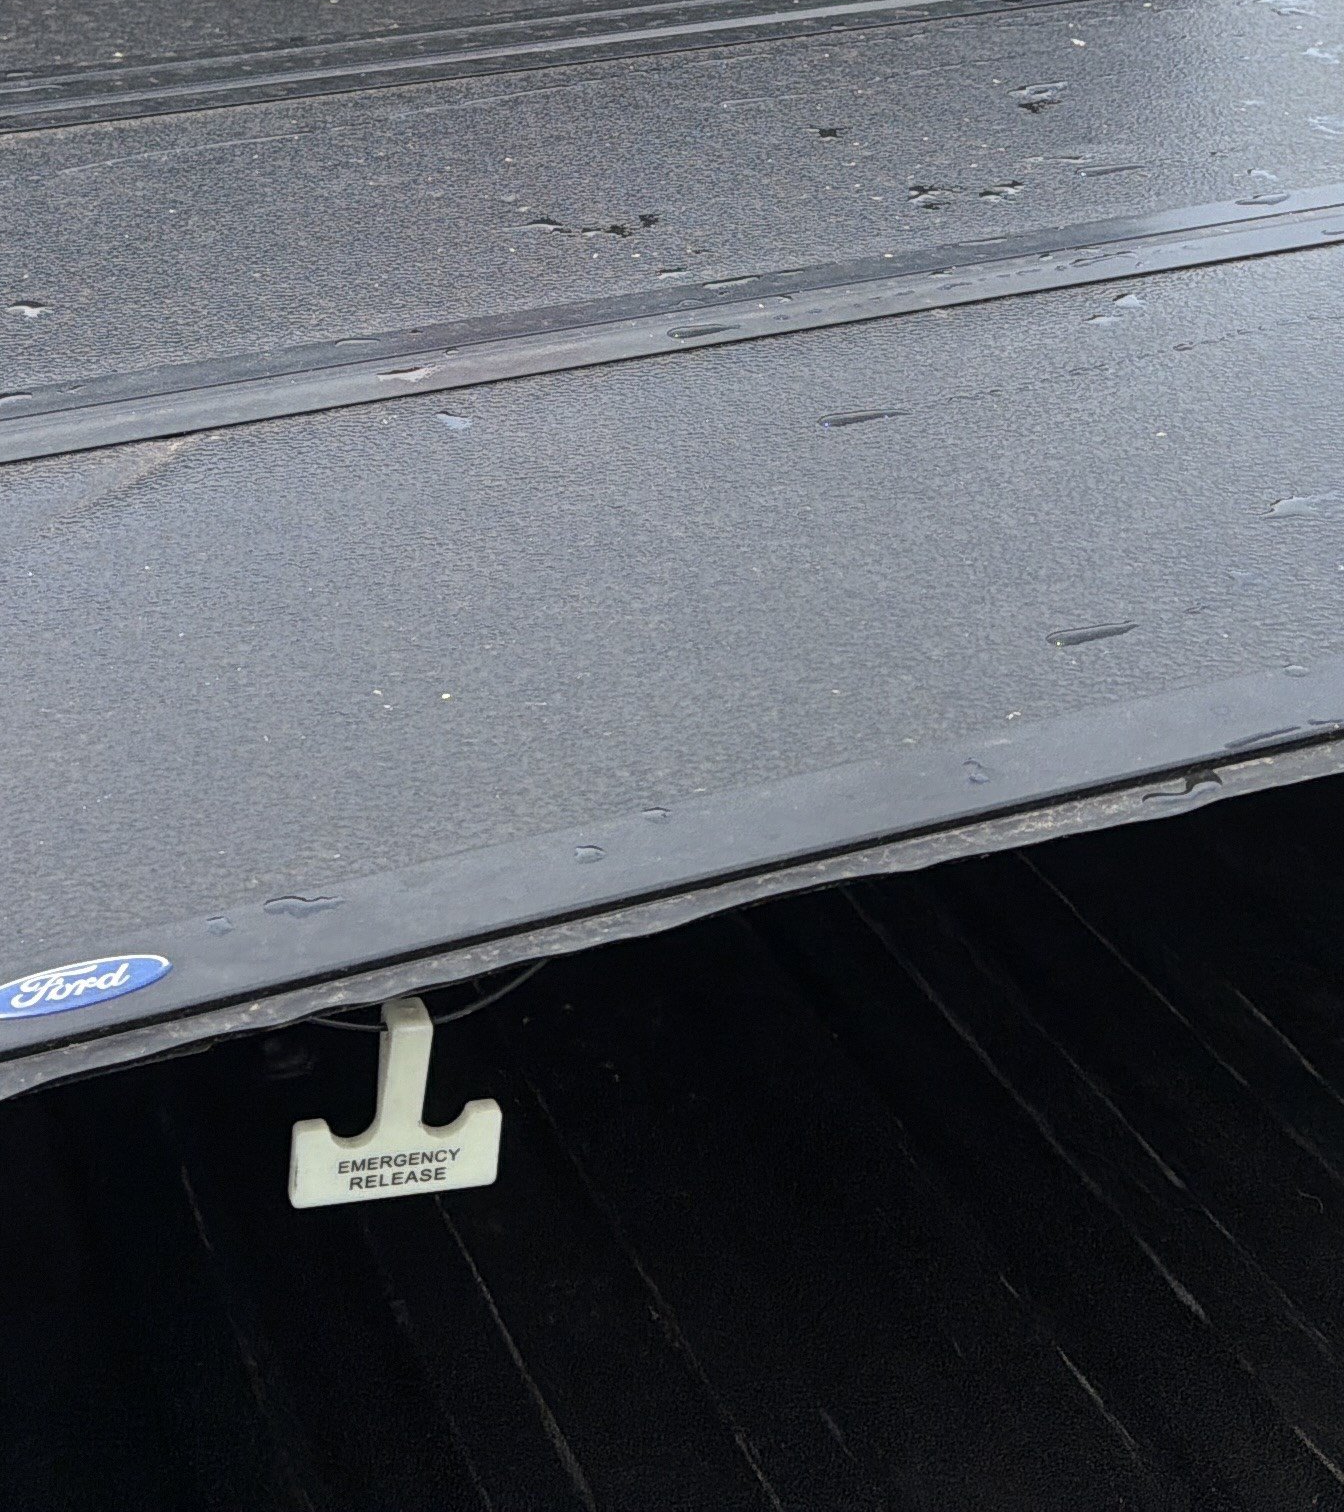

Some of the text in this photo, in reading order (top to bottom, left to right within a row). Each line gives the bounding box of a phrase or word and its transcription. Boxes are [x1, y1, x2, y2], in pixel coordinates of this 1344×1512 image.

[10, 962, 131, 1009] Ford
[337, 1147, 461, 1175] EMERGENCY
[348, 1167, 448, 1191] RELEASE
